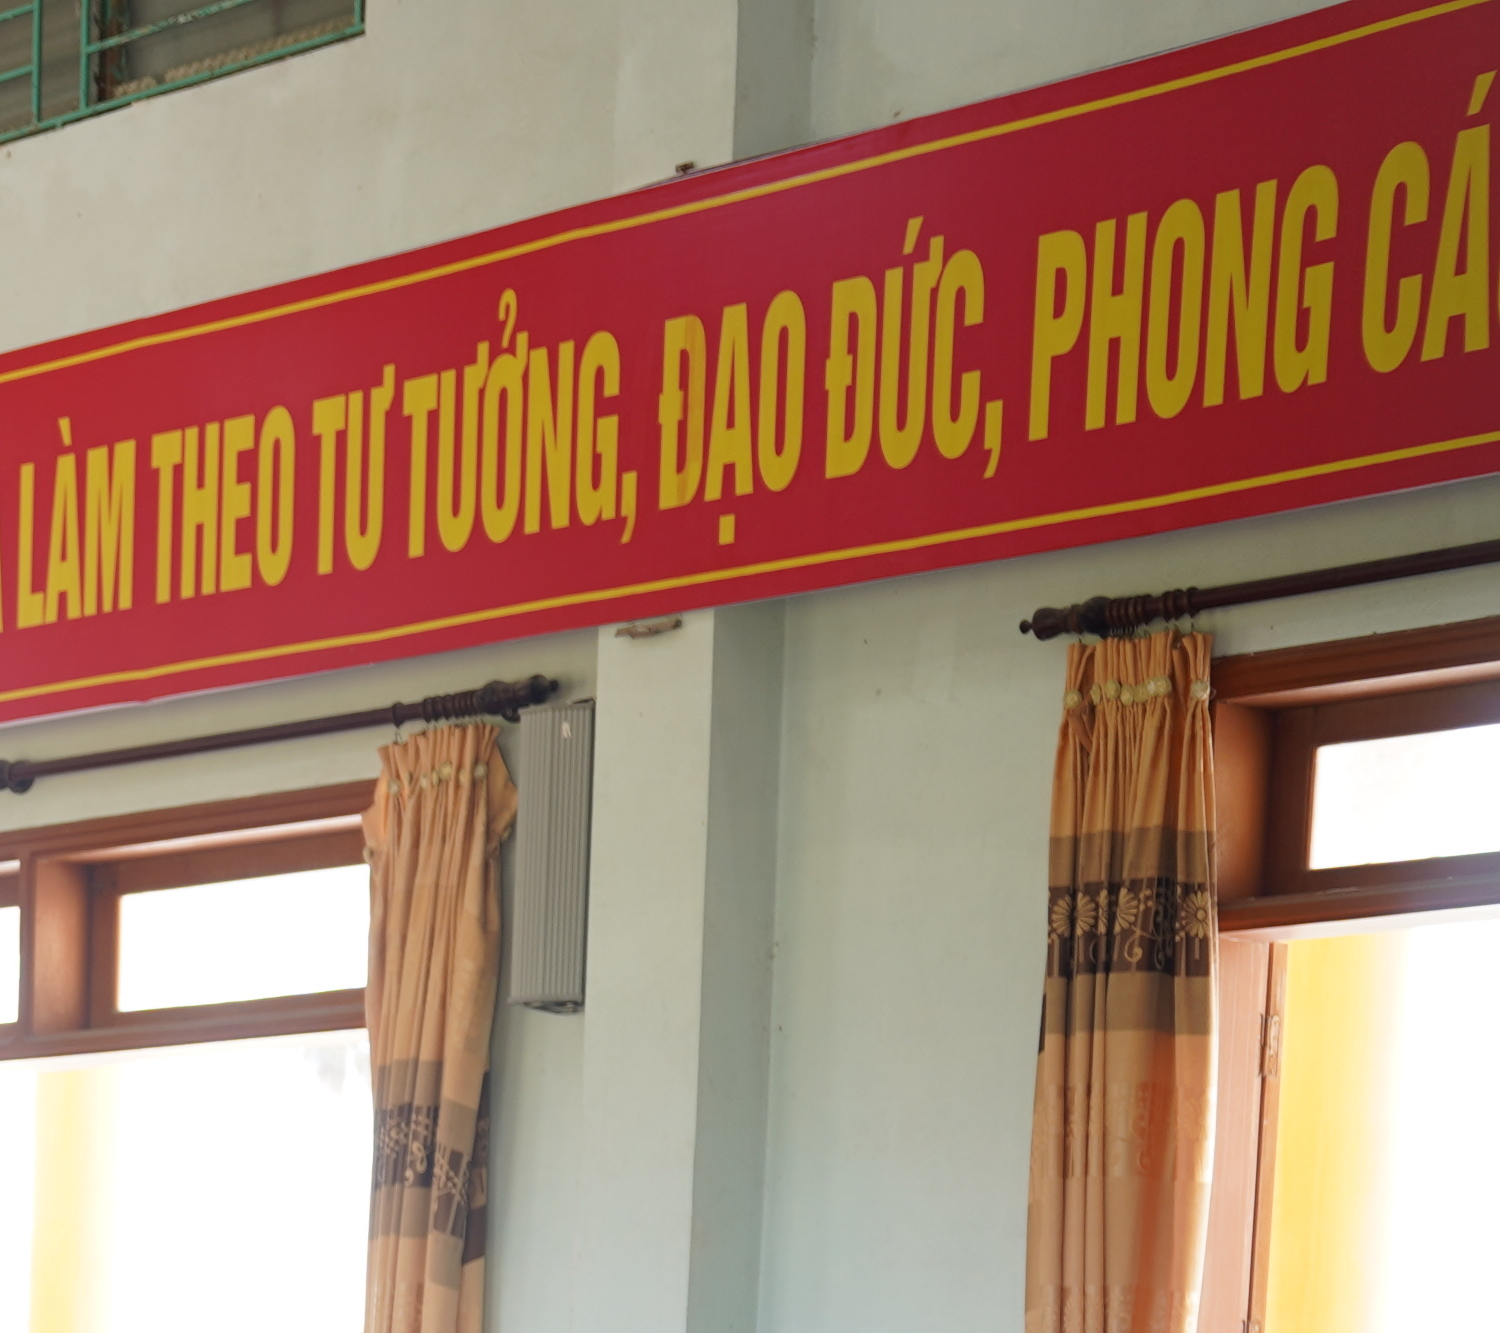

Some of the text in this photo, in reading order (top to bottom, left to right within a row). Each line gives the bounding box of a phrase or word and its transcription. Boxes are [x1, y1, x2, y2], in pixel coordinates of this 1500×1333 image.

[17, 416, 136, 631] LÀM
[151, 404, 295, 605] THEO
[311, 362, 397, 575] TƯ
[403, 287, 638, 558] TƯỞNG,
[659, 289, 806, 546] ĐẠO
[825, 215, 1004, 479] ĐỨC,
[1029, 164, 1338, 442] PHONG
[1362, 70, 1500, 375] CÁ
